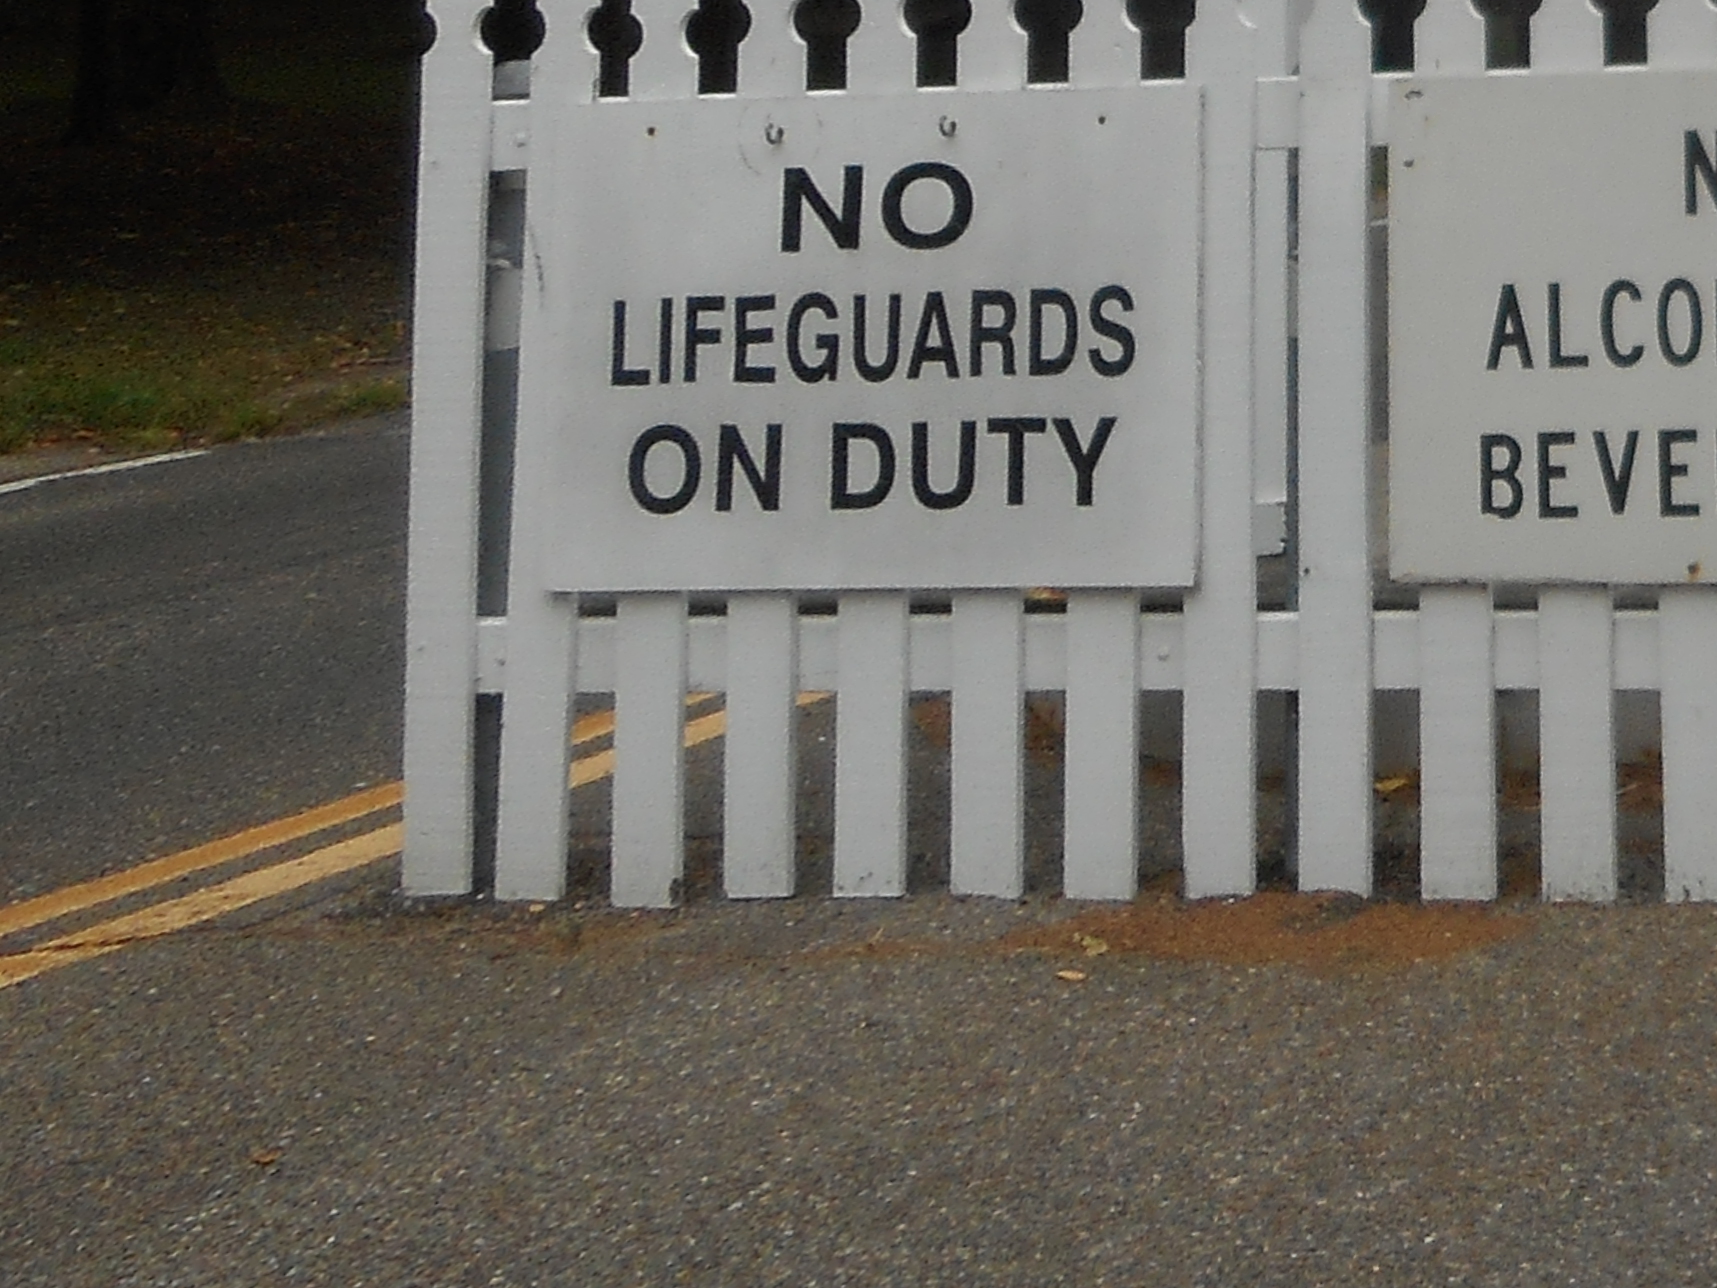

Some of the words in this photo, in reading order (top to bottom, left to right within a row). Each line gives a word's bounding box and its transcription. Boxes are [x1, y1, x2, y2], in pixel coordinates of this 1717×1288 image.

[780, 162, 974, 253] NO
[611, 284, 1137, 387] LIFEGUARDS
[628, 422, 783, 516] ON
[830, 416, 1117, 511] DUTY
